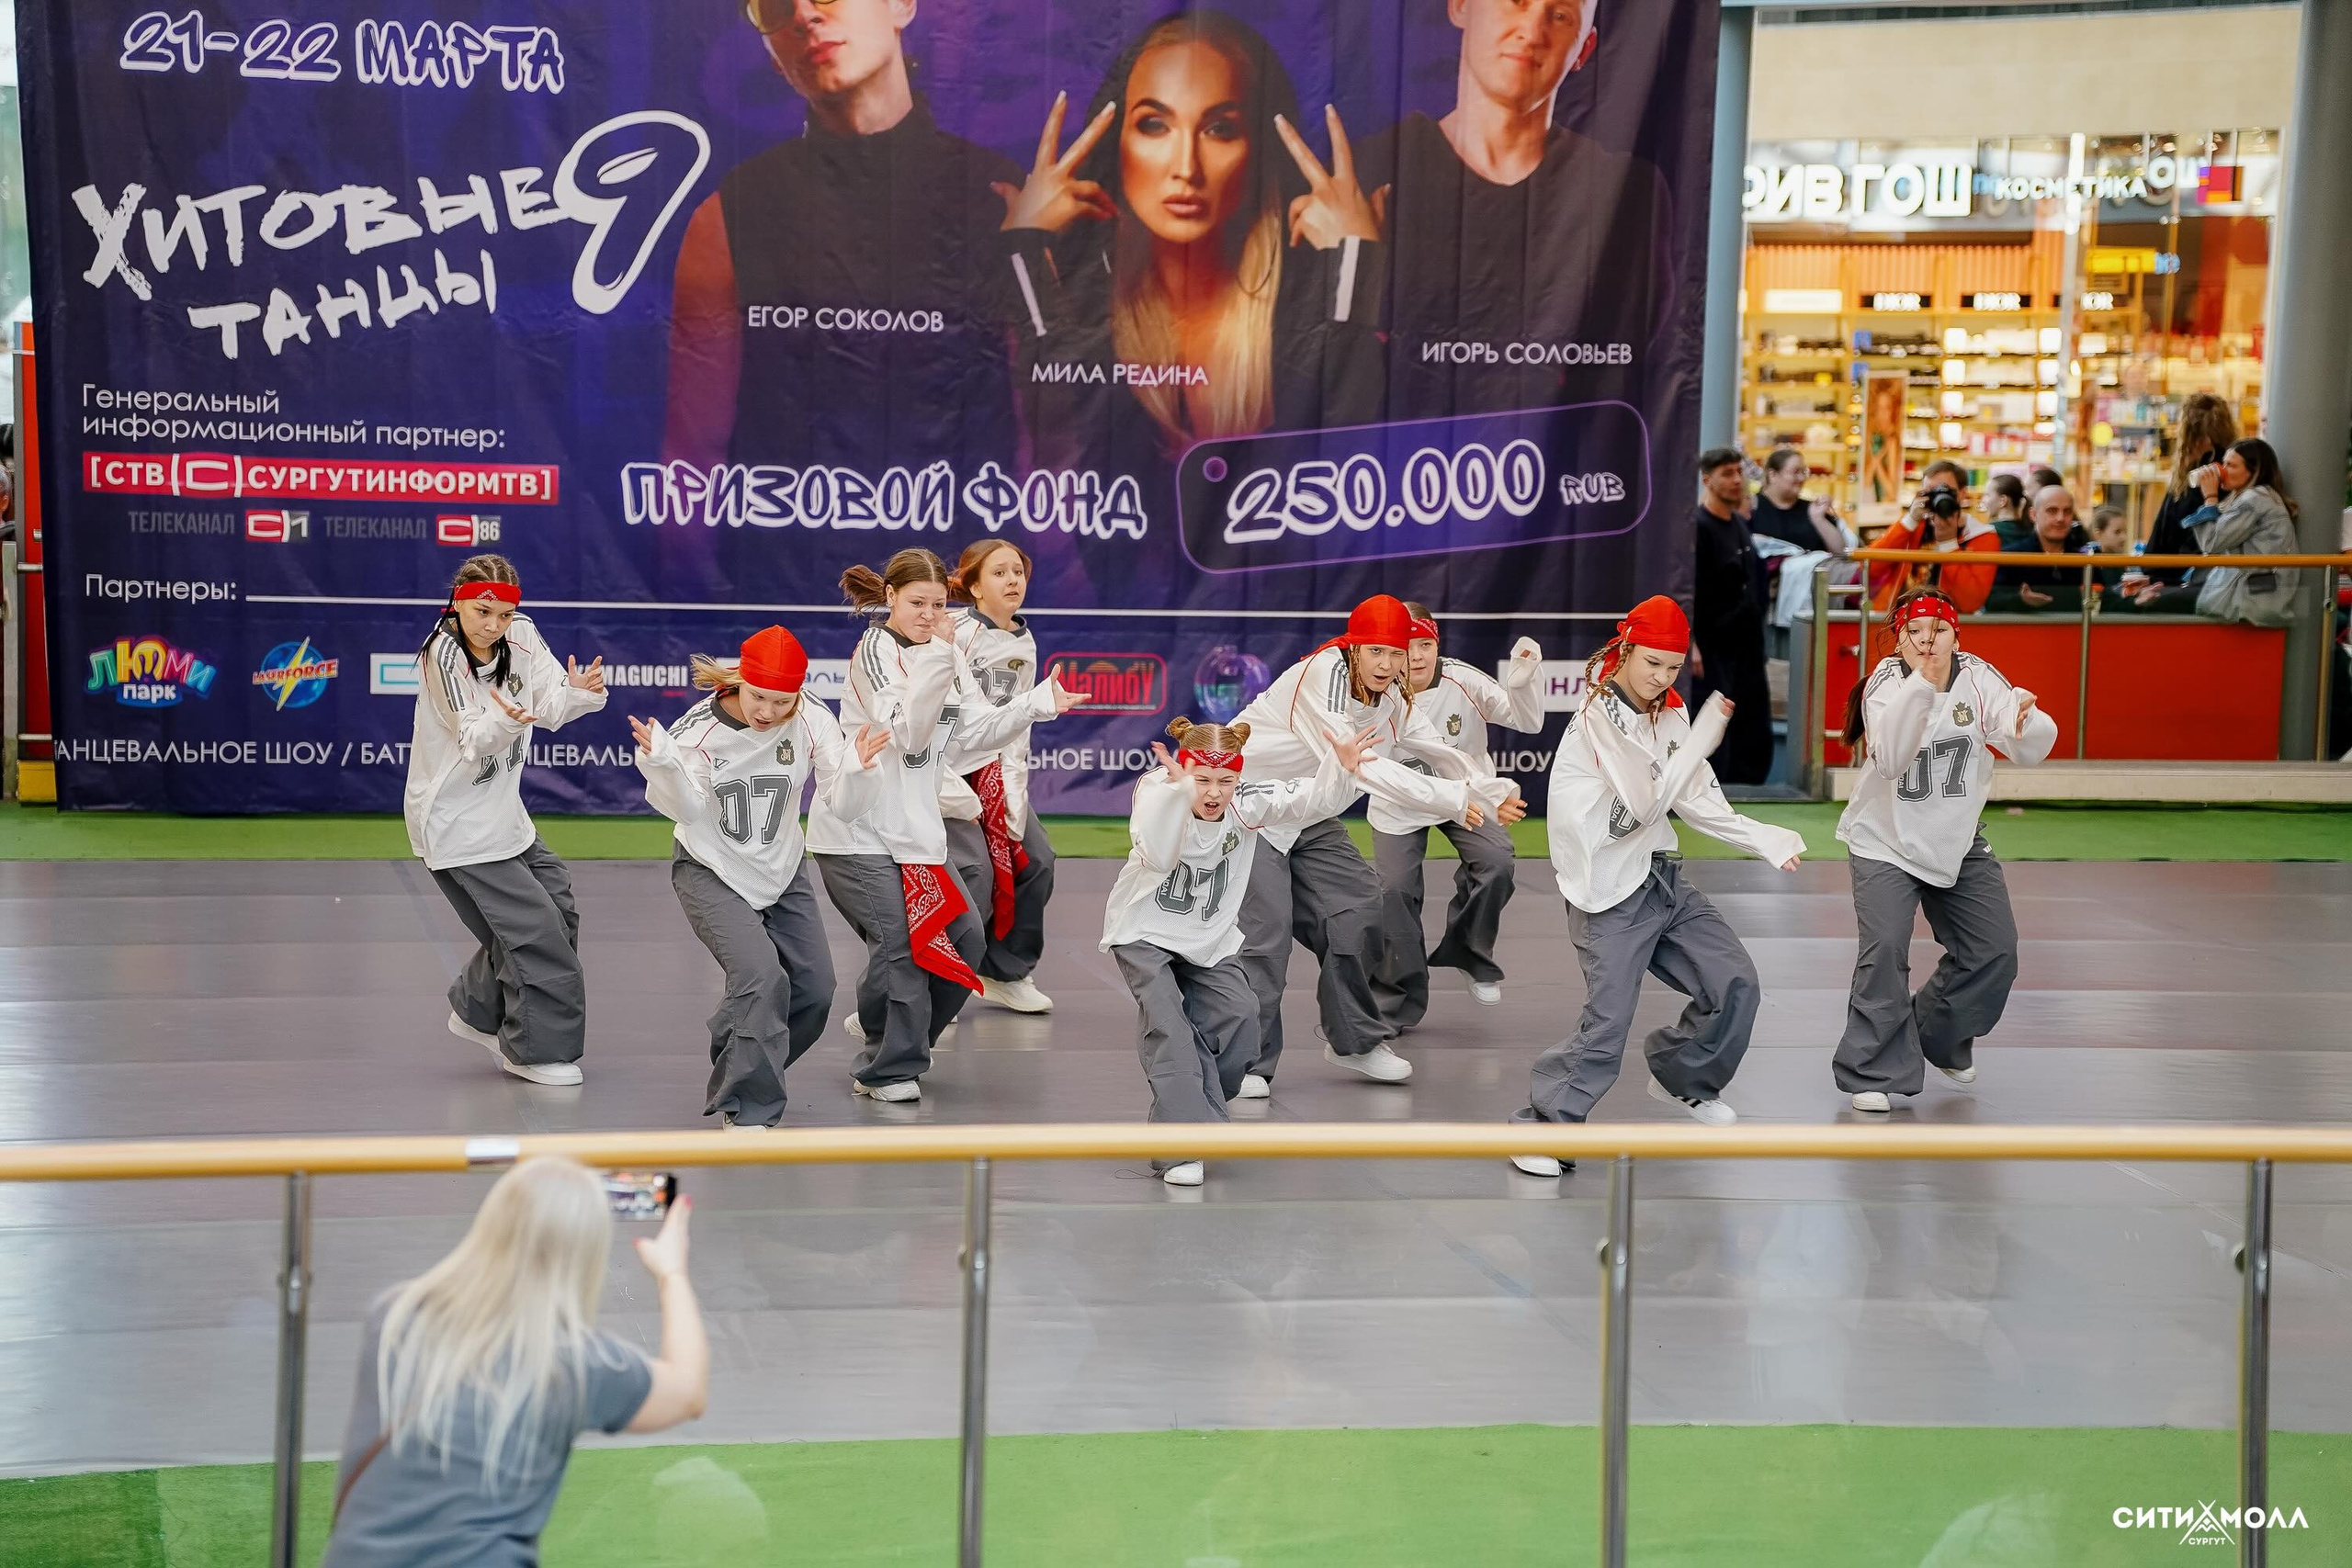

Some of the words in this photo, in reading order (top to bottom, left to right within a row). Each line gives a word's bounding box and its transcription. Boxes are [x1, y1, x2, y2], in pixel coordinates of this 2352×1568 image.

[120, 10, 341, 82] 21-22
[355, 18, 565, 94] МАРТА
[72, 166, 562, 301] ХИТОВЫЕ
[187, 249, 497, 359] ТАНЦЫ
[748, 306, 809, 328] ЕГОР
[815, 308, 944, 333] СОКОЛОВ
[1422, 342, 1499, 364] ИГОРЬ
[1505, 343, 1633, 365] СОЛОВЬЕВ
[1031, 362, 1106, 384] МИЛА
[1113, 364, 1208, 387] РЕДИНА
[83, 383, 279, 415] Генеральный
[83, 412, 367, 445] информационный
[376, 424, 506, 453] партнер:
[620, 459, 956, 532] ПРИЗОВОЙ
[963, 461, 1148, 540] ФОНД
[1224, 438, 1545, 544] 250.000
[1559, 471, 1625, 505] RUB
[129, 511, 235, 535] ТЕЛЕКАНАЛ
[324, 516, 427, 539] ТЕЛЕКАНАЛ
[86, 574, 236, 604] Партнеры:
[122, 682, 176, 705] парк
[266, 741, 334, 764] ШОУ
[527, 744, 638, 769] ЦЕВАЛЬ
[1493, 750, 1553, 773] ШОУ
